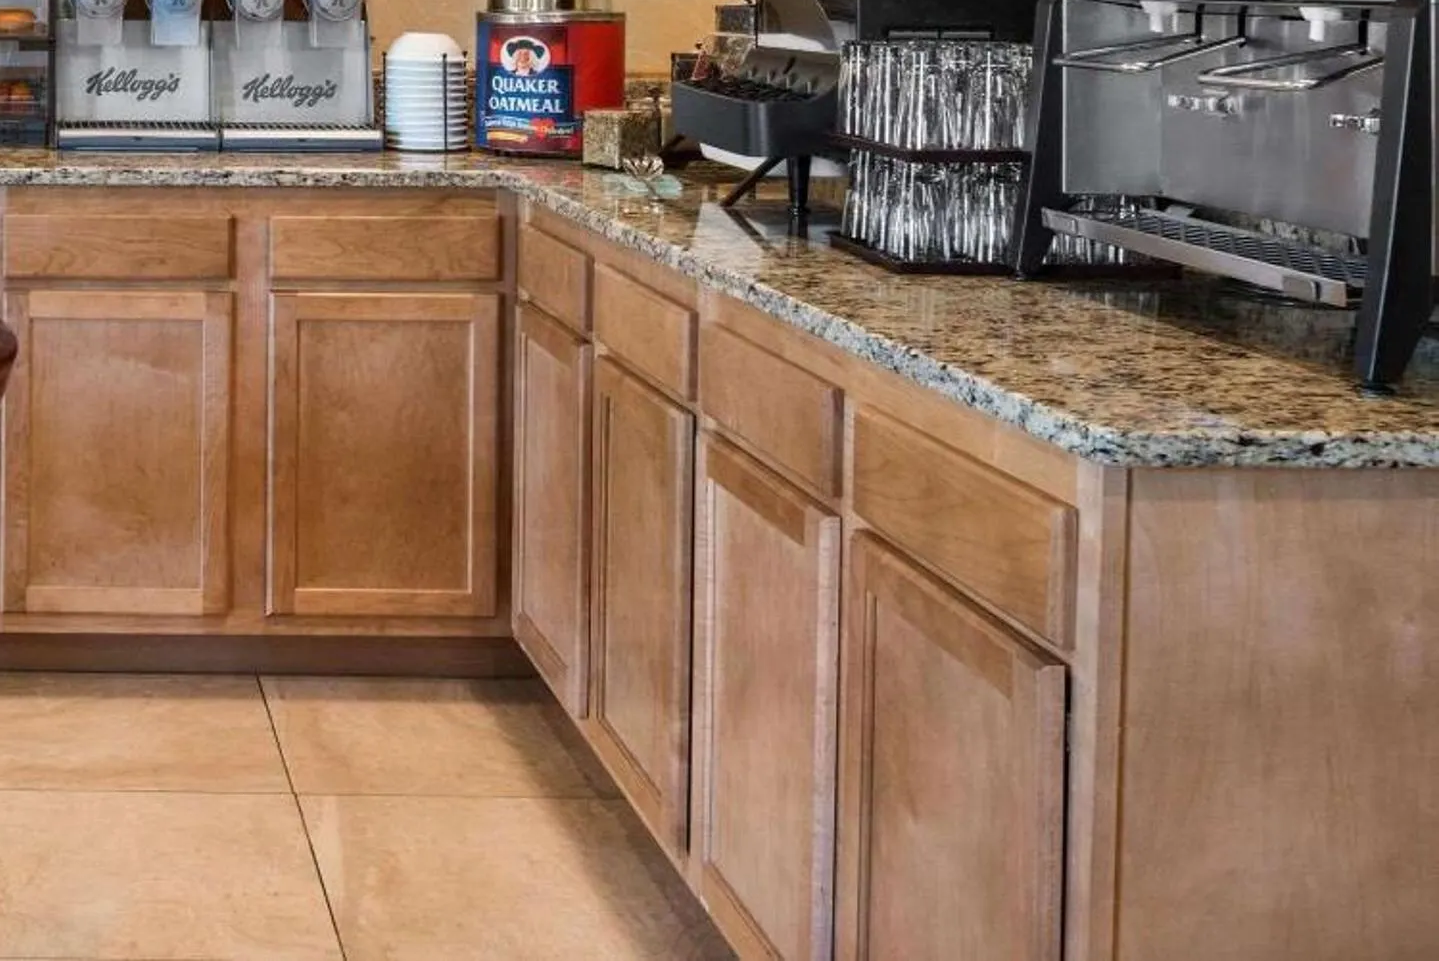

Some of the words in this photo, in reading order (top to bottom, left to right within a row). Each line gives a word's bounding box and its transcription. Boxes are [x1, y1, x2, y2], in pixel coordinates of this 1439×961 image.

[86, 66, 181, 101] Kellogg's
[242, 73, 338, 107] Kellogg's
[492, 75, 560, 94] QUAKER
[488, 96, 564, 114] OATMEAL
